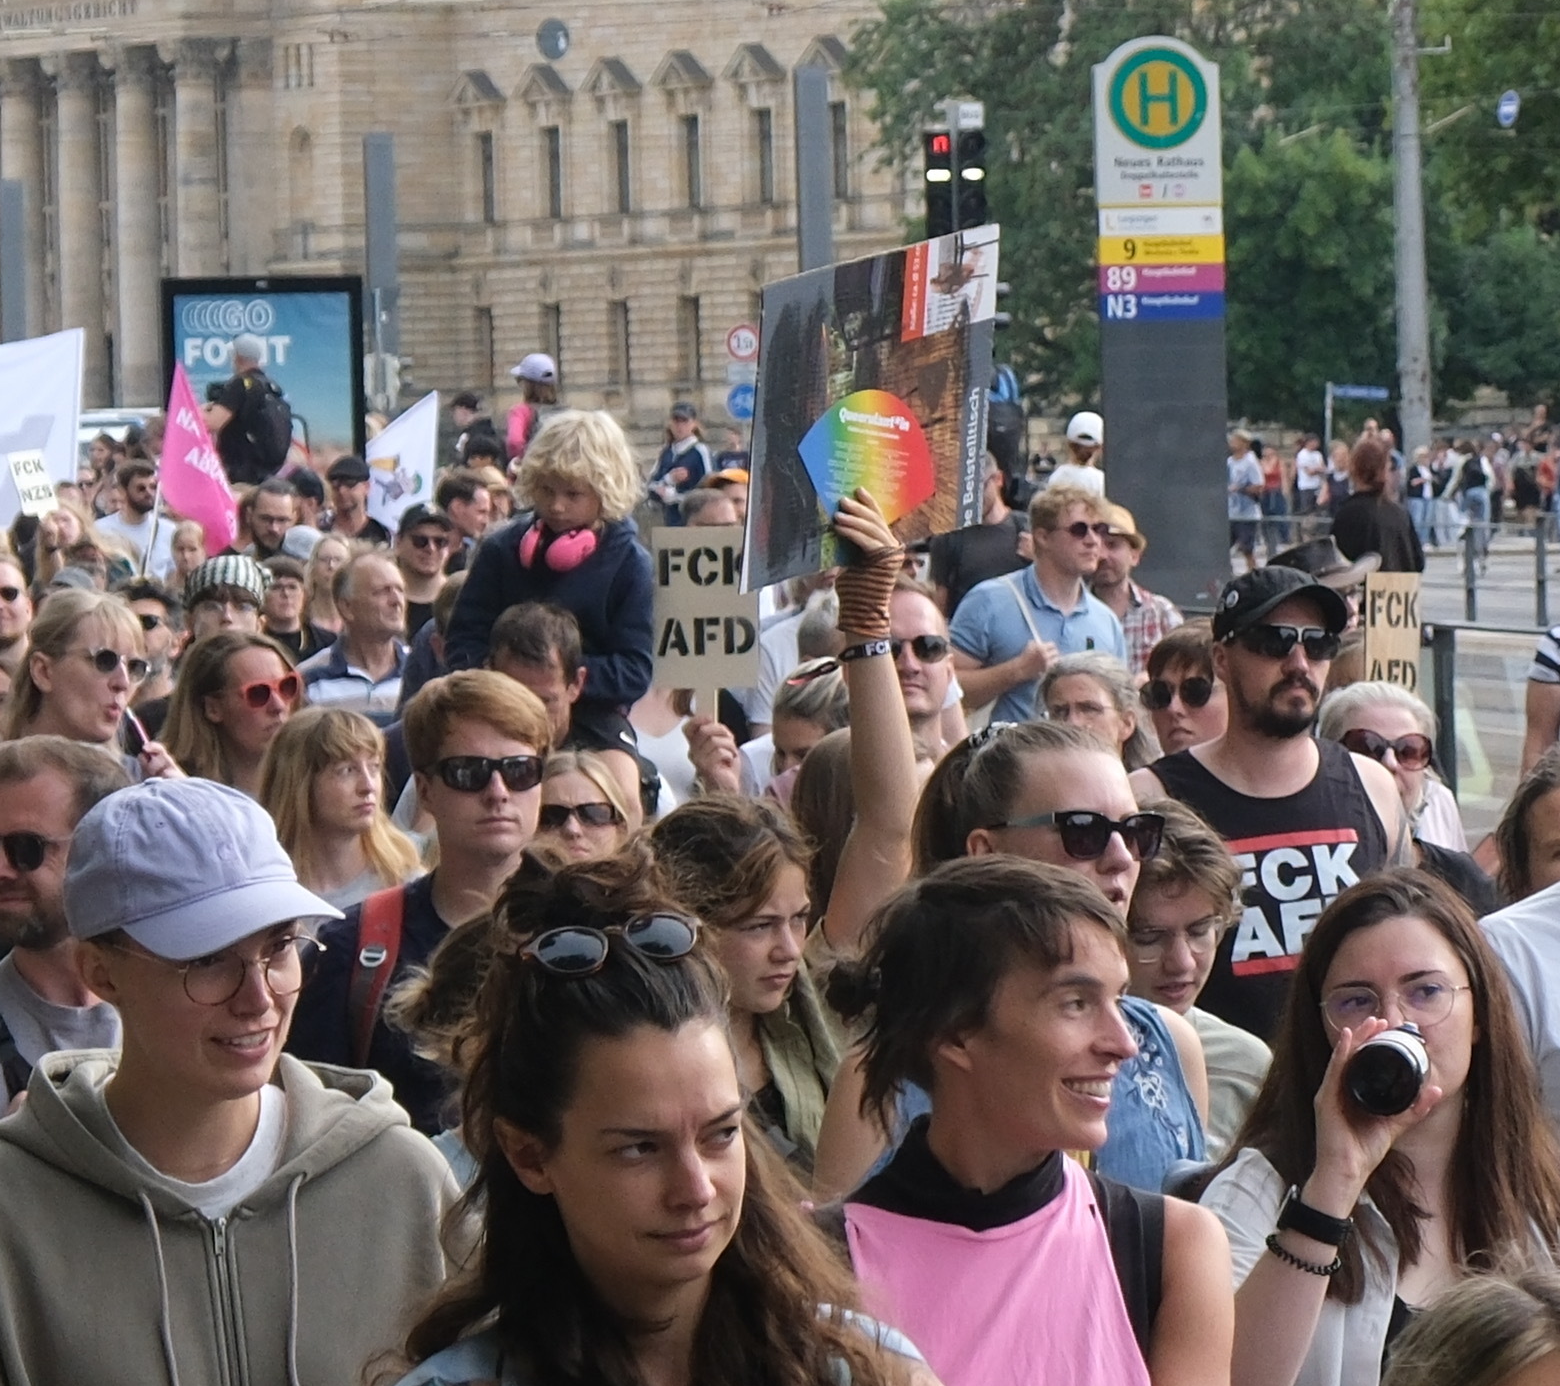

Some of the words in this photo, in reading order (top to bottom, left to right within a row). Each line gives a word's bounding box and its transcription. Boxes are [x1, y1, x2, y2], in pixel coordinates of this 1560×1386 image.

[1139, 69, 1178, 126] H
[1156, 155, 1204, 168] Rathaus
[1123, 238, 1137, 261] 9
[1107, 266, 1138, 291] 89
[1106, 294, 1138, 319] N3
[183, 336, 234, 367] FO
[962, 386, 981, 506] Beistelltisch
[12, 461, 45, 477] FCK
[21, 484, 54, 503] NZS
[1369, 588, 1418, 629] FCK
[657, 616, 757, 658] AFD
[1369, 658, 1416, 694] AFD
[1234, 842, 1361, 902] FCK
[1230, 897, 1330, 964] AF
